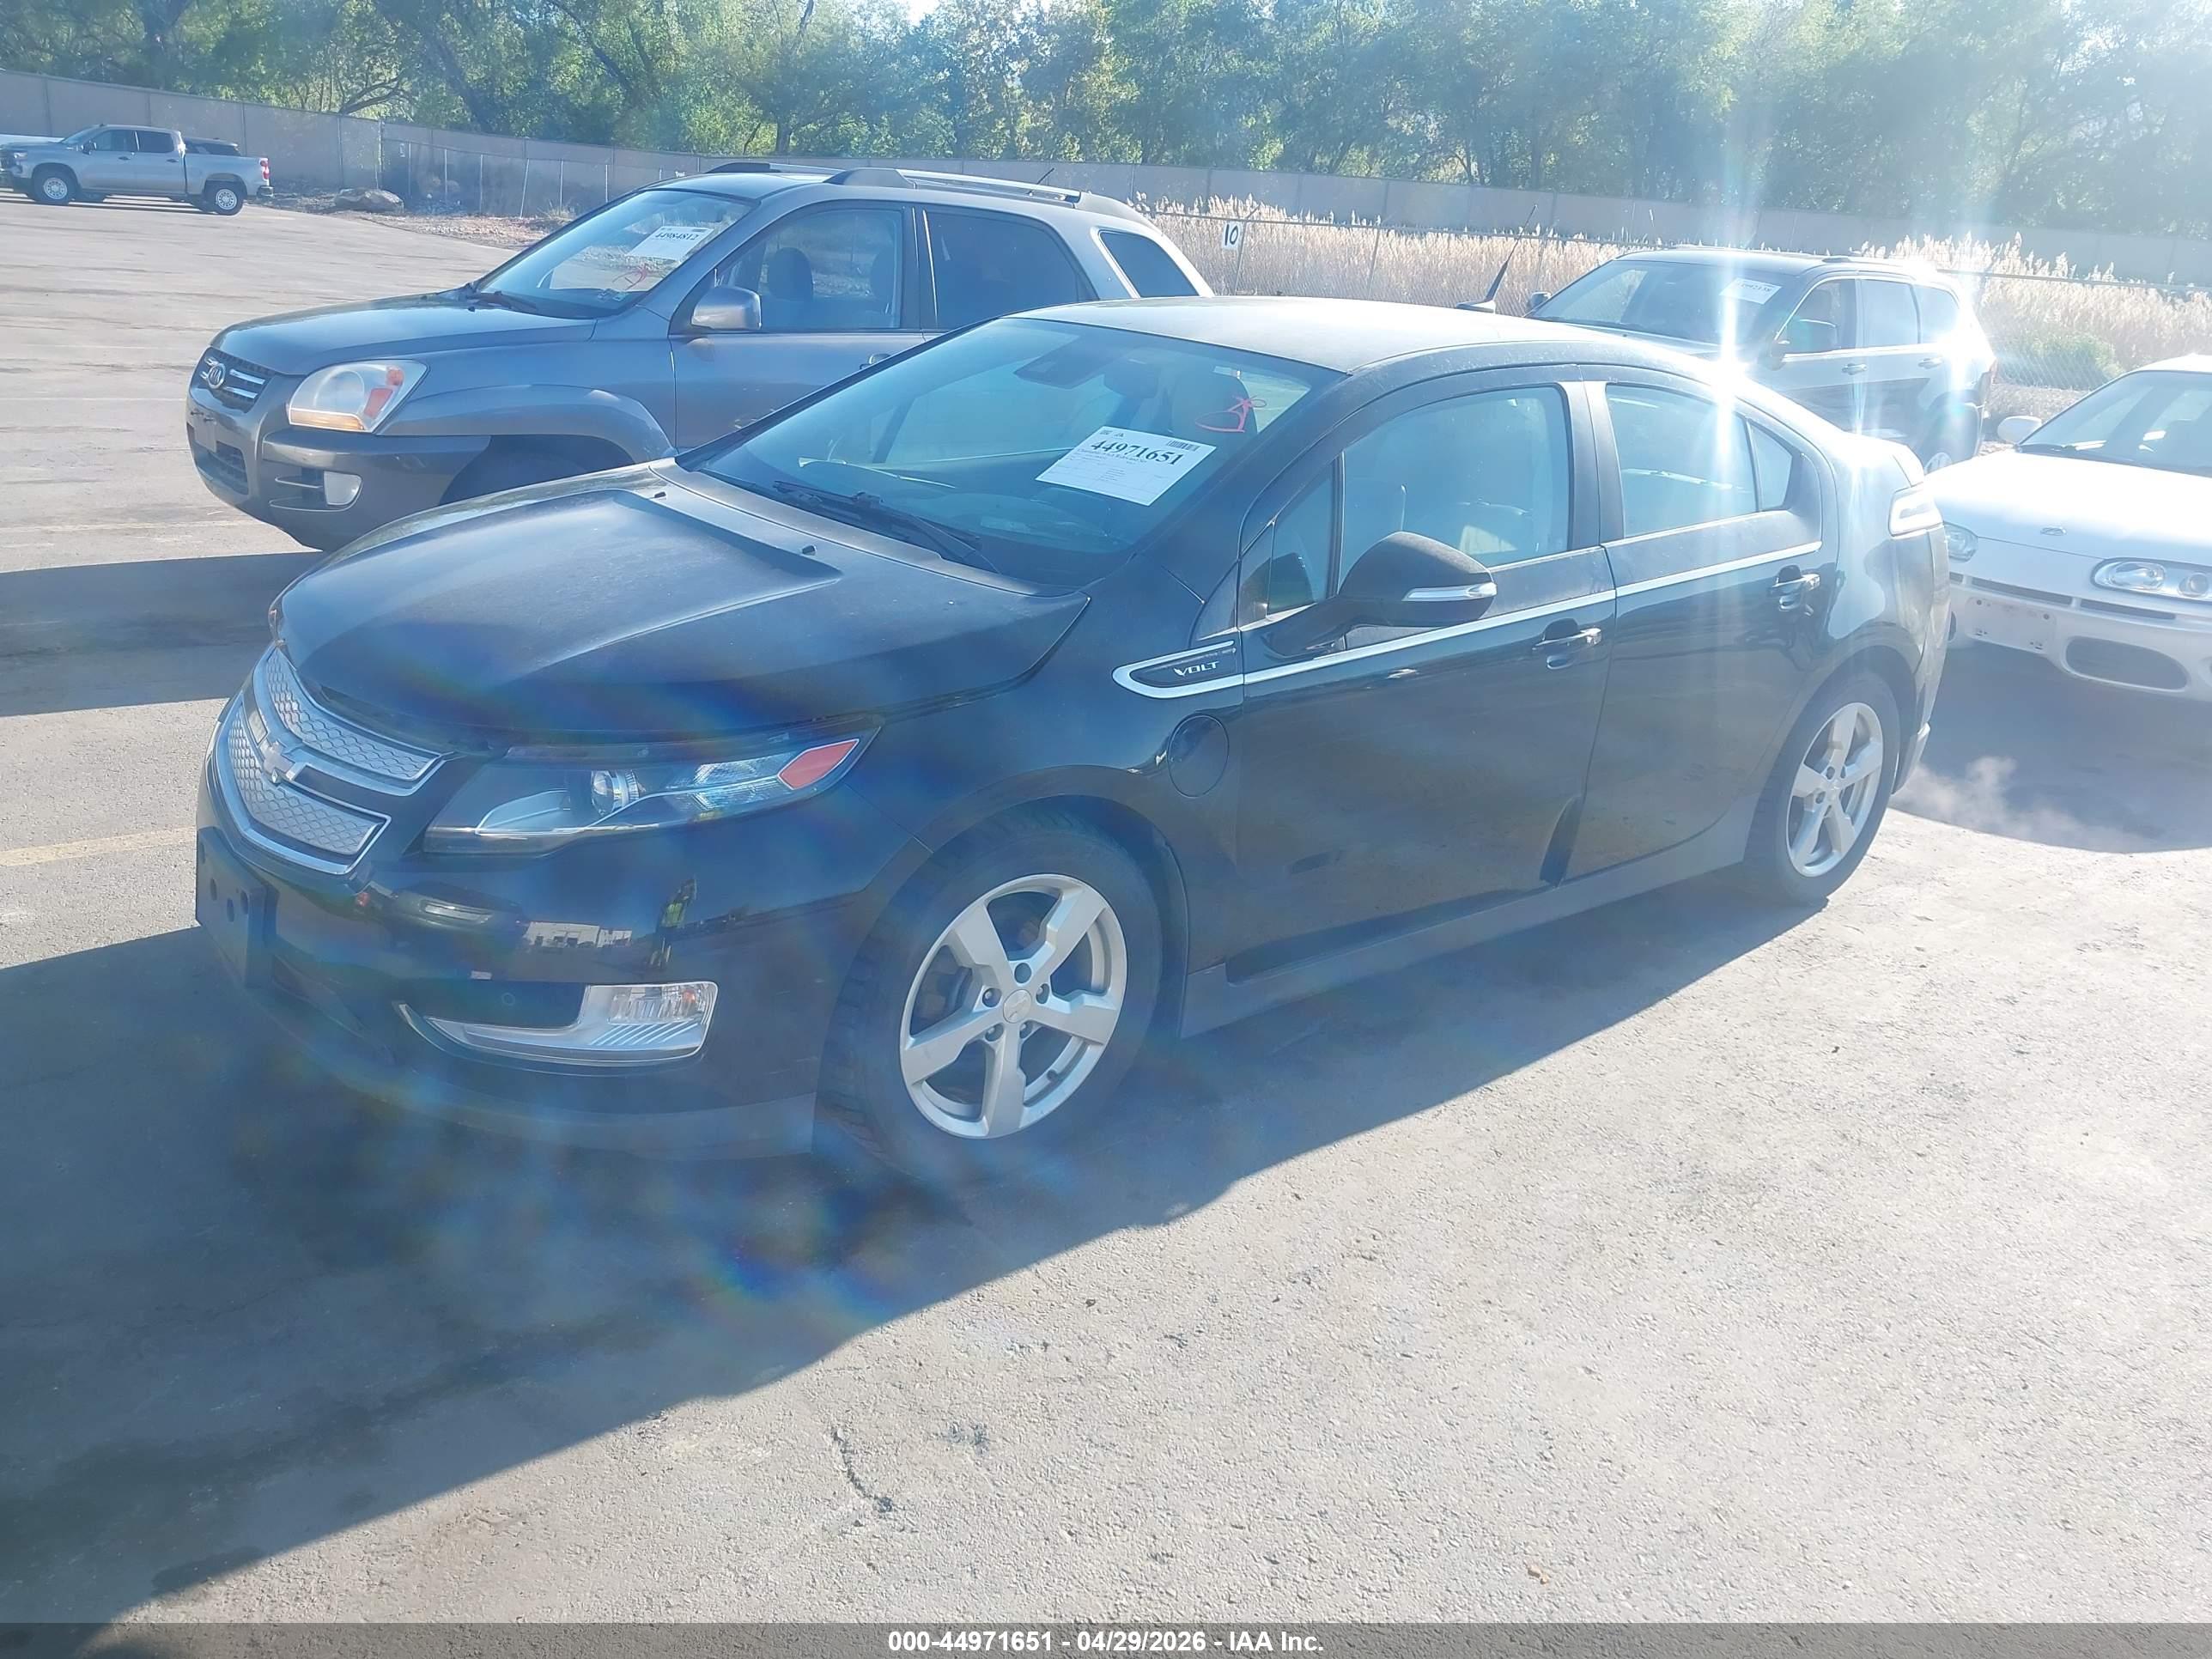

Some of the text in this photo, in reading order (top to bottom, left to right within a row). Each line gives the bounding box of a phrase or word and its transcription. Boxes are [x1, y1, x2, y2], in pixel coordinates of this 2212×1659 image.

[1224, 223, 1239, 246] 10
[1091, 440, 1184, 465] 44971651
[1173, 660, 1220, 677] VOLT
